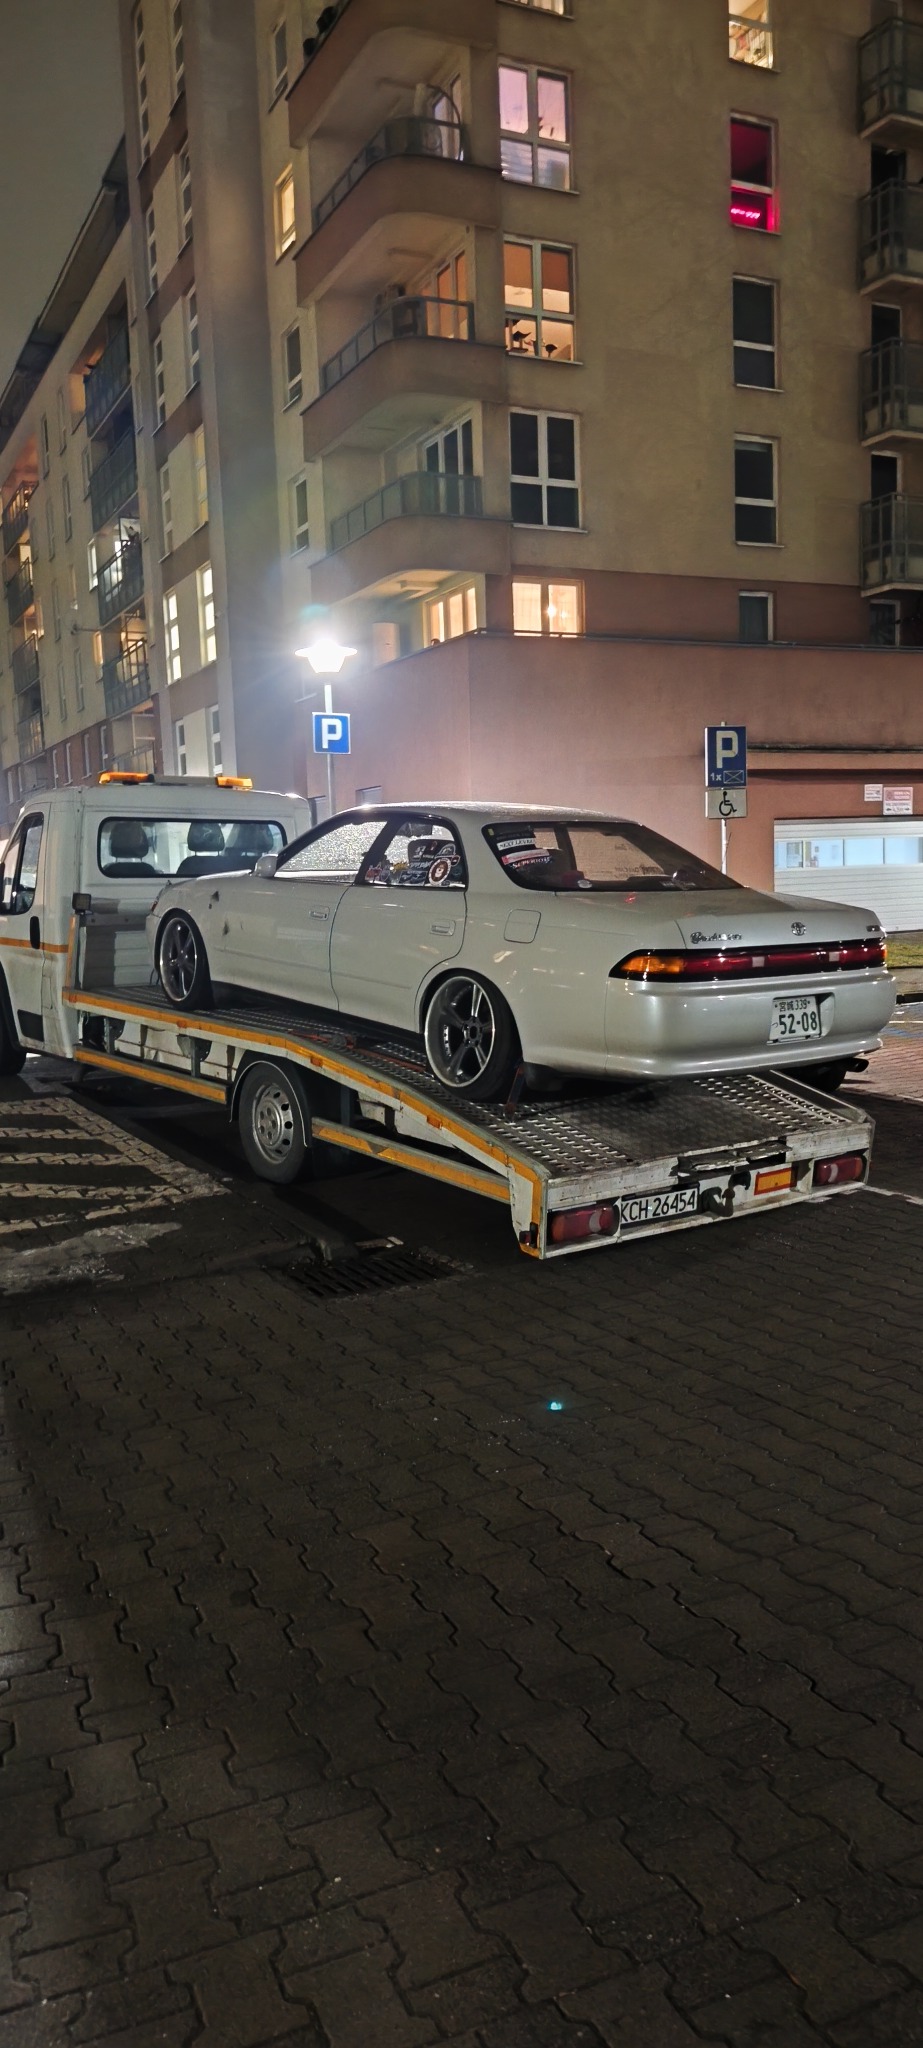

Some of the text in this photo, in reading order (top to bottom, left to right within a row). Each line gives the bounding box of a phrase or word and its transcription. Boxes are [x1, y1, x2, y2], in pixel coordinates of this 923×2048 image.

[321, 718, 342, 749] P
[716, 730, 739, 769] P
[710, 772, 722, 781] 1x
[779, 1011, 818, 1035] 52-08
[620, 1190, 696, 1222] KCH 26454
